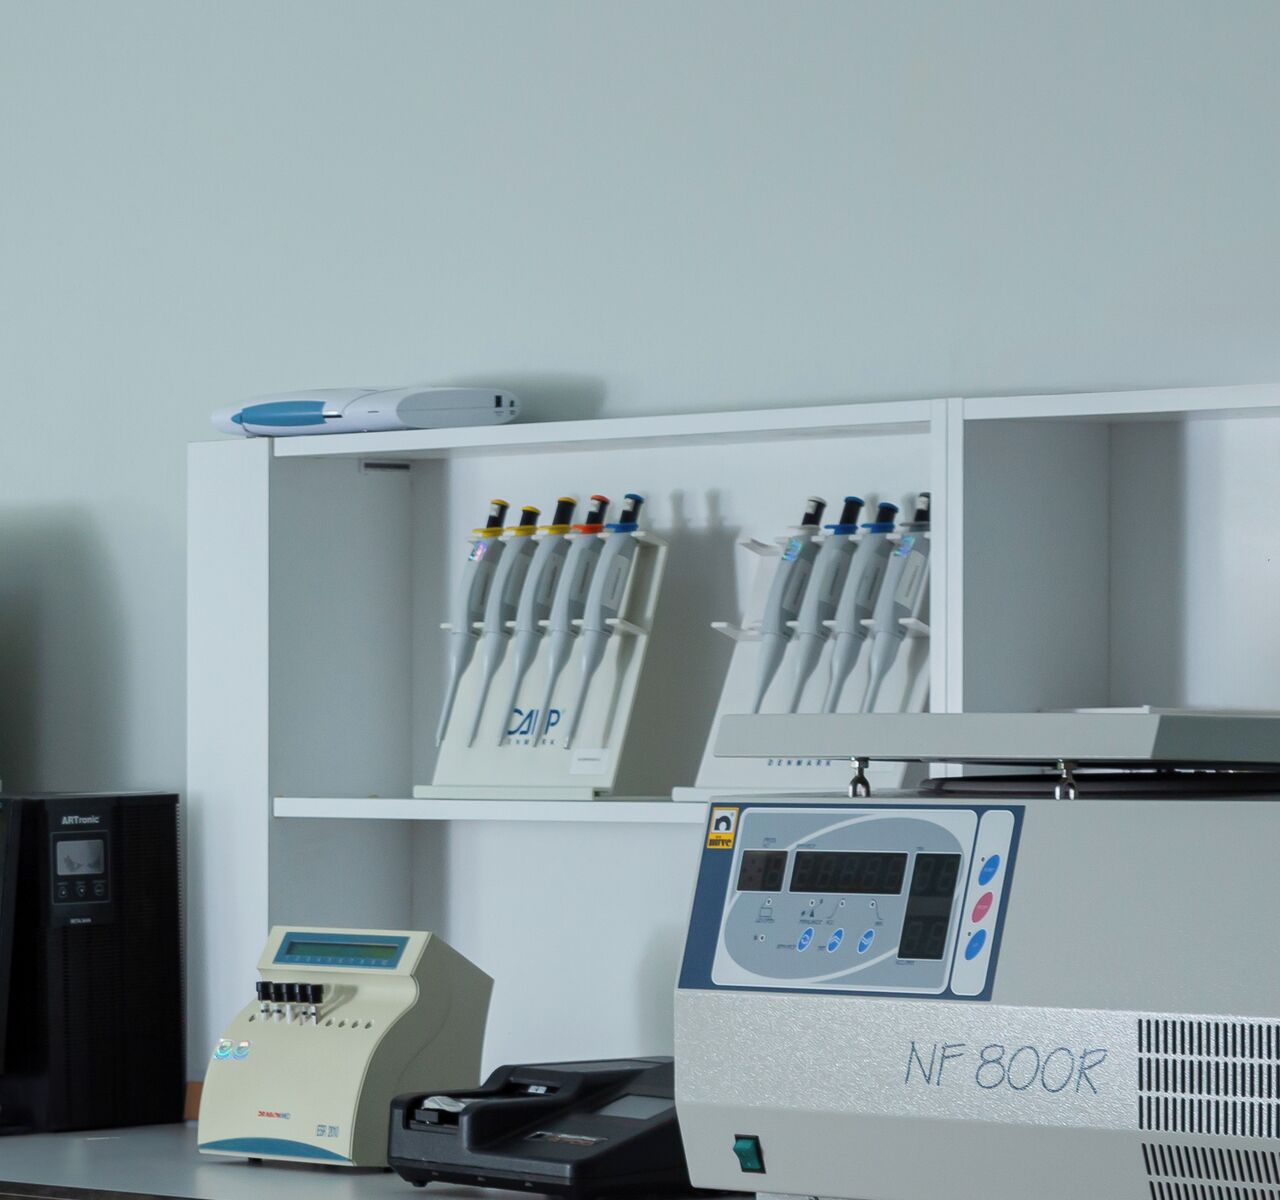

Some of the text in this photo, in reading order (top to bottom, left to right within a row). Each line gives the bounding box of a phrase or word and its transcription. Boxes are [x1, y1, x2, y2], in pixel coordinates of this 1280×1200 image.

[506, 708, 561, 736] CAP
[905, 1041, 1108, 1094] NF 800R
